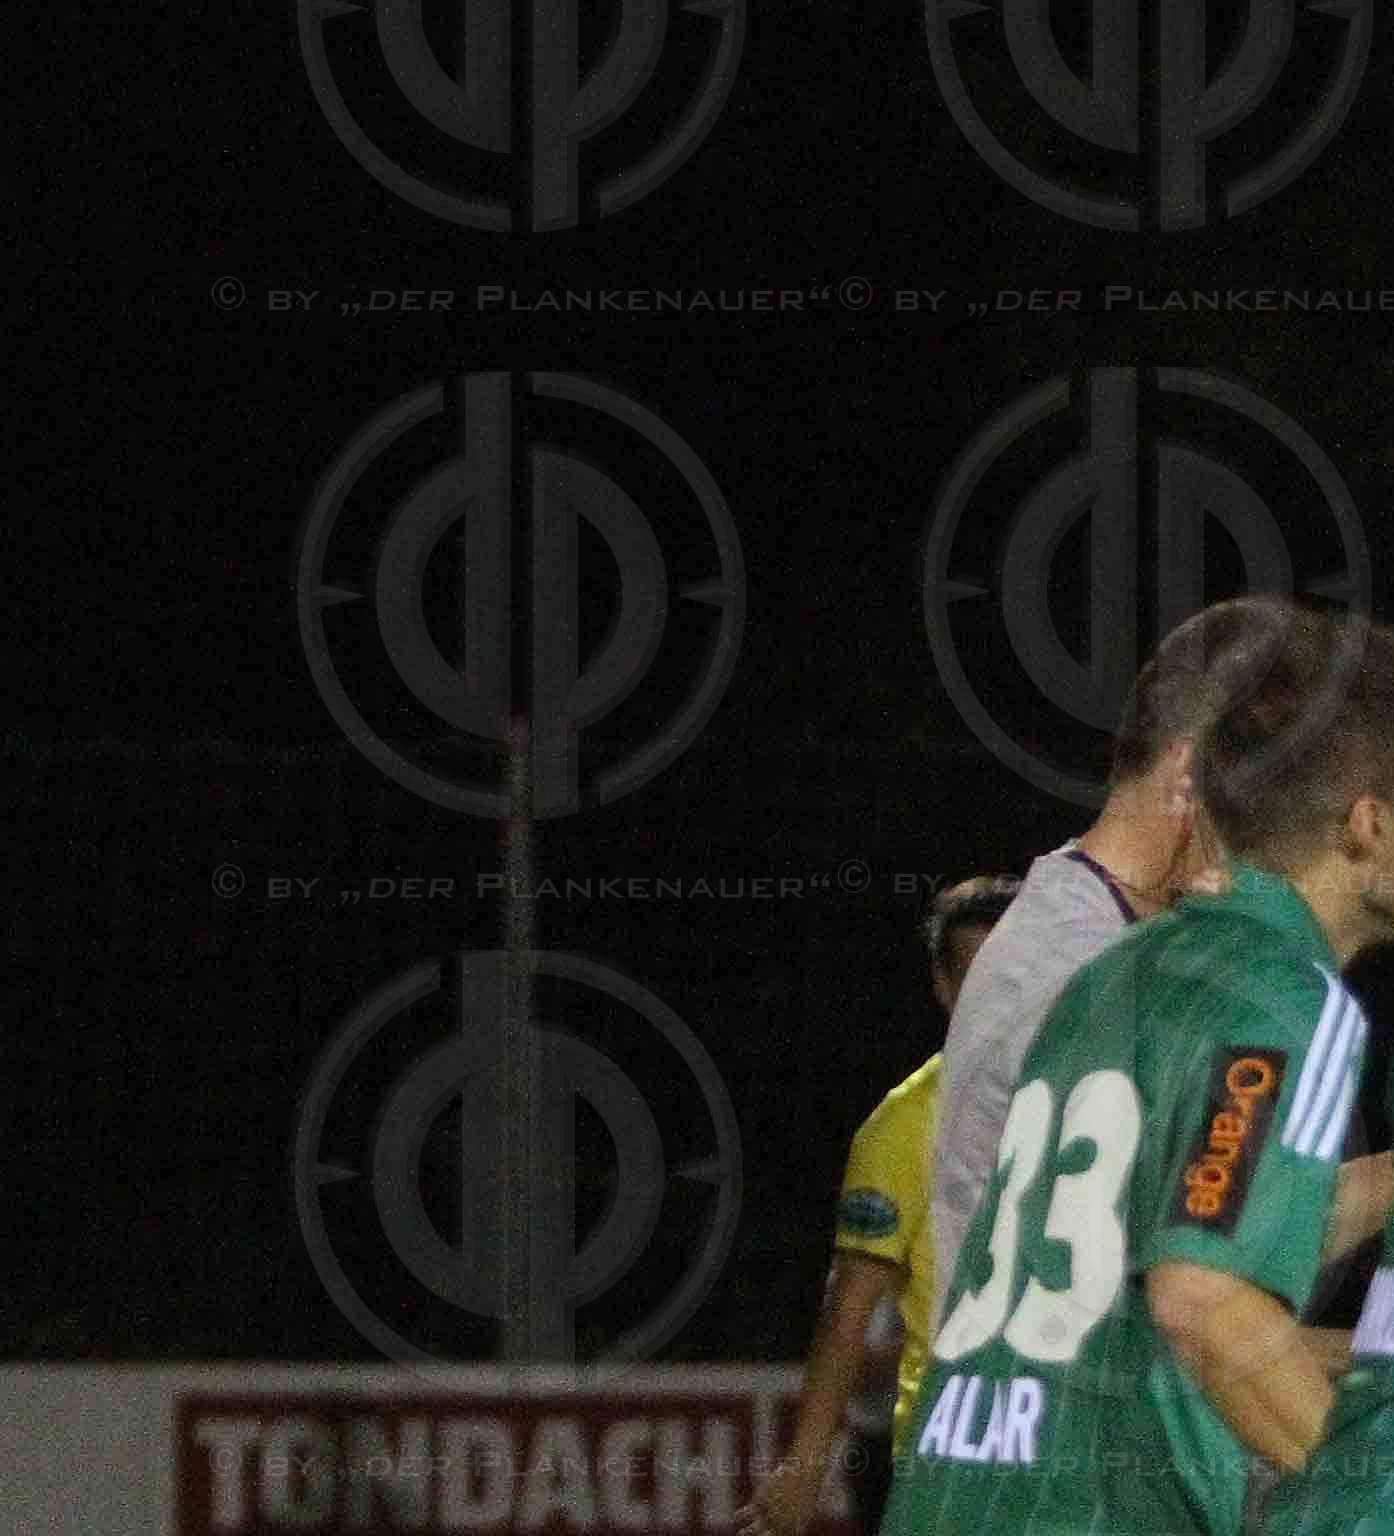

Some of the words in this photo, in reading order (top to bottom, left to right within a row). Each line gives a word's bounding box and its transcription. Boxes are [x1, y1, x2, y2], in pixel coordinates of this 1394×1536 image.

[934, 1069, 1141, 1364] 33
[195, 1414, 737, 1530] TONDACH
[917, 1374, 1043, 1463] ALAR
